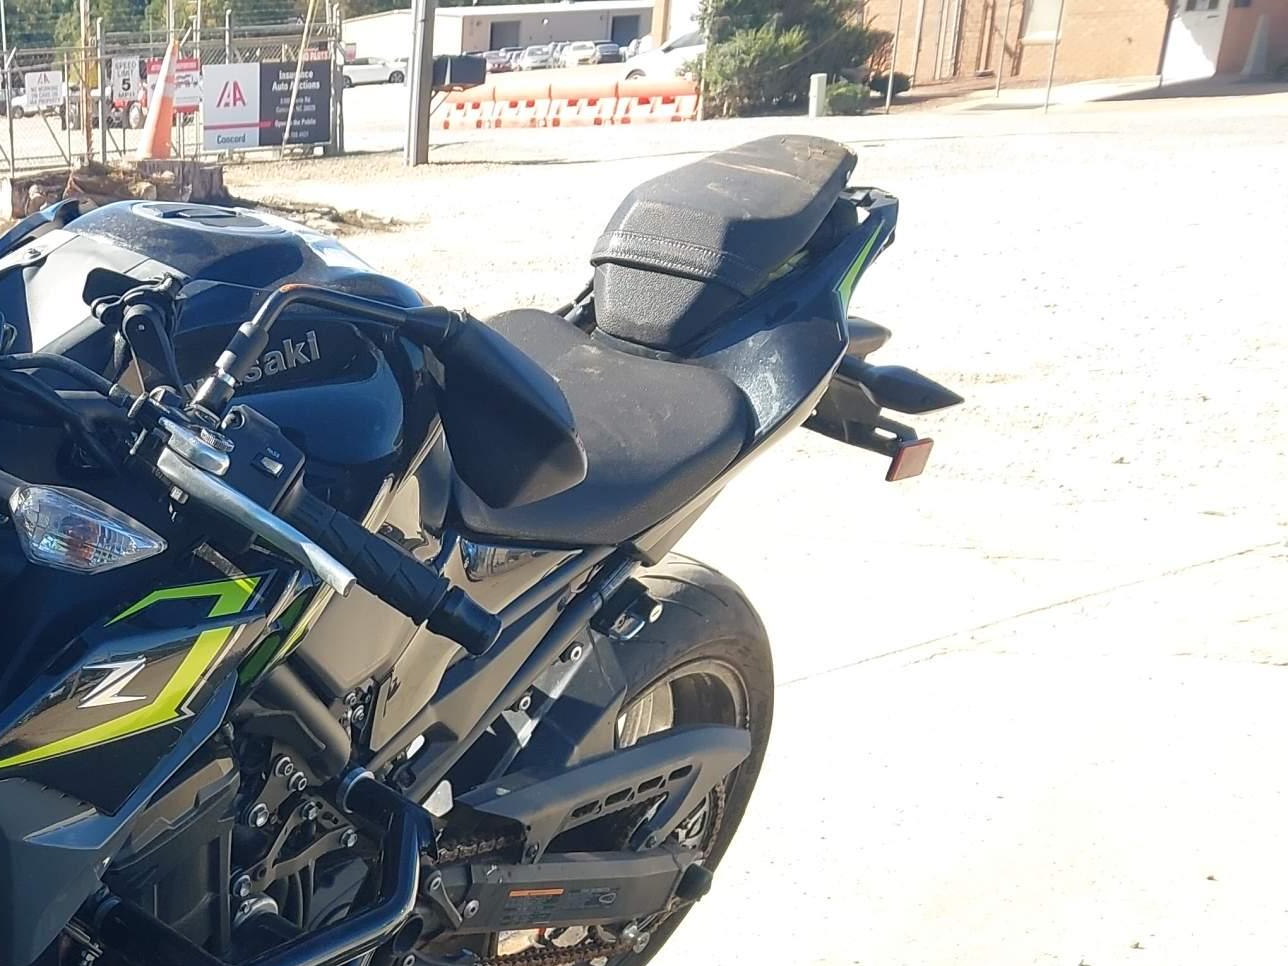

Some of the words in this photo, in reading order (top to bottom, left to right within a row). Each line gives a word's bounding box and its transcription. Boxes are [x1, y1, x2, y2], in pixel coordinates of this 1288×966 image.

[279, 70, 314, 80] Insunce
[122, 78, 131, 91] 5
[272, 81, 289, 91] Auto
[289, 80, 320, 90] Actions
[217, 133, 246, 144] Concord
[242, 330, 320, 384] saki
[77, 655, 147, 709] Z
